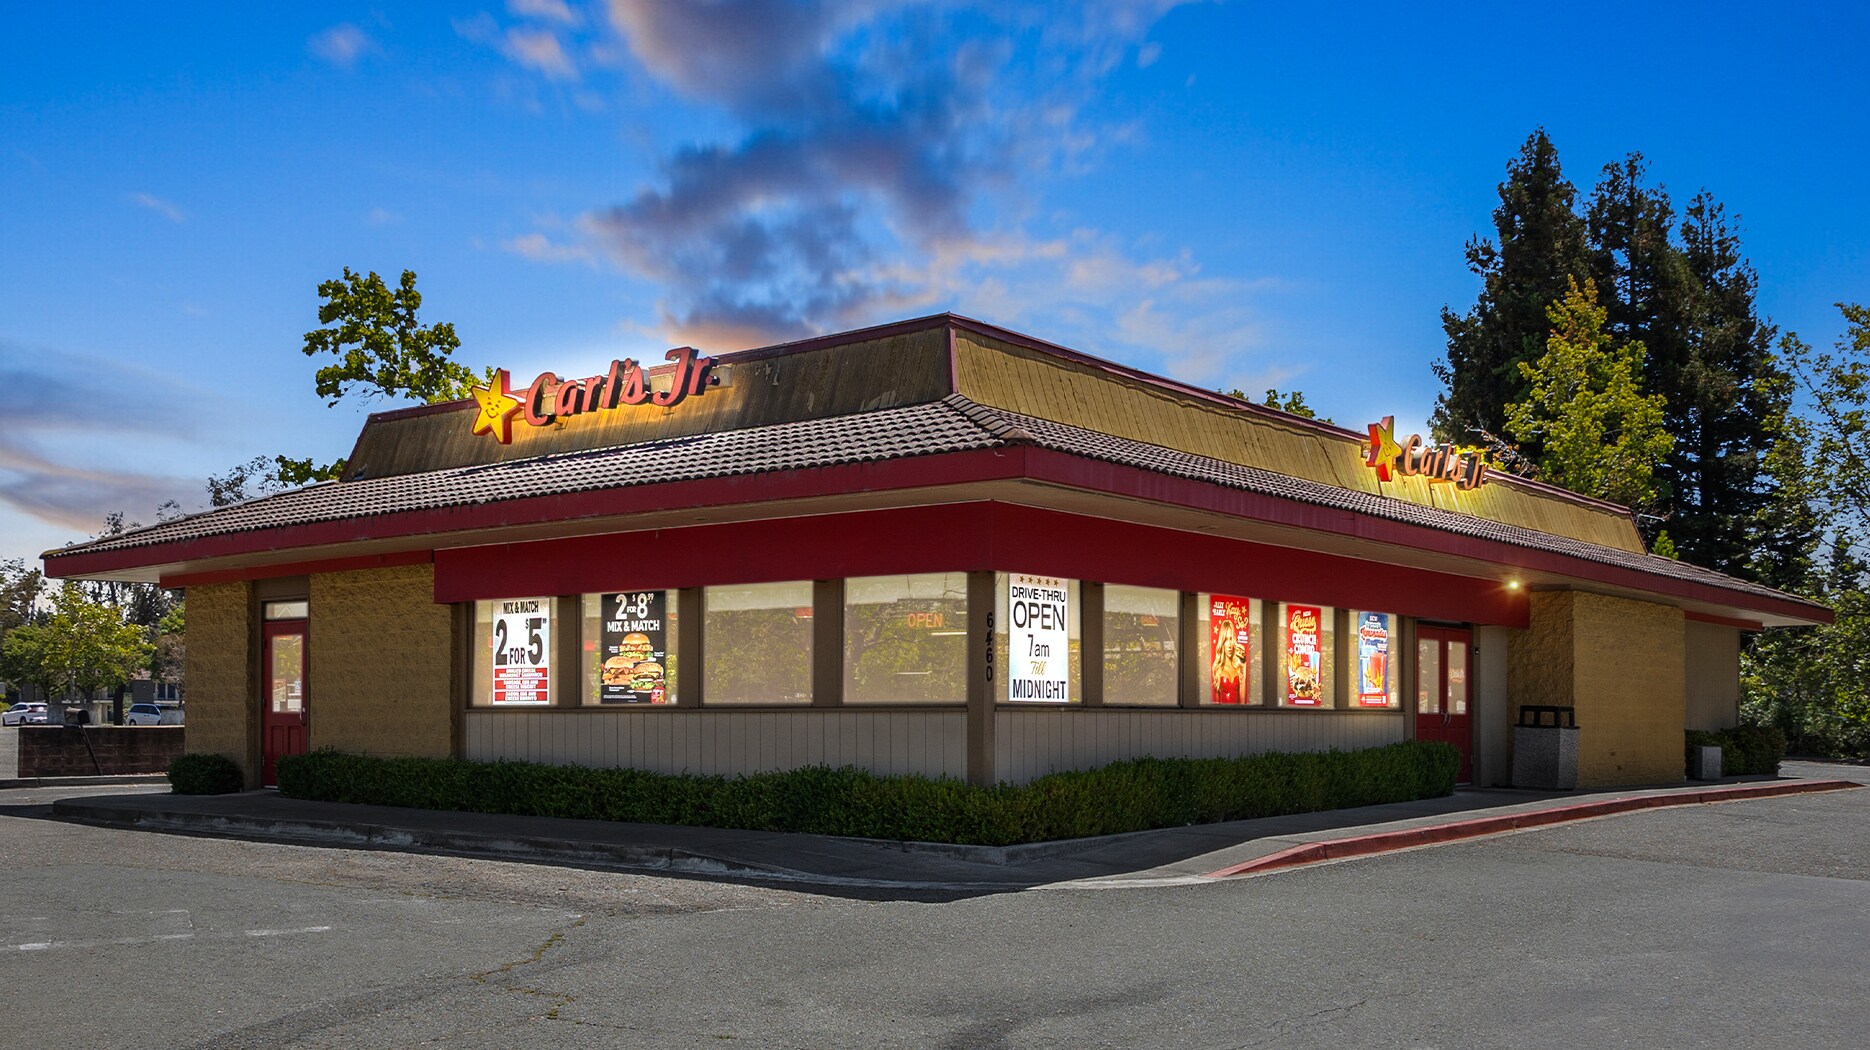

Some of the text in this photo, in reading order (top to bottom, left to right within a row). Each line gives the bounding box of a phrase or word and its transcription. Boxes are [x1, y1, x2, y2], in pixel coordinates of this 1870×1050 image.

[524, 346, 720, 427] Carl's Jr.
[1398, 433, 1461, 482] Carl's
[1012, 586, 1066, 603] DRIVE-THRU
[503, 601, 539, 614] MIX & MATCH
[615, 594, 627, 620] 2
[1013, 600, 1065, 631] OPEN
[607, 620, 660, 632] MIX & MATCH
[908, 611, 945, 629] OPEN
[495, 619, 508, 666] 2
[509, 647, 526, 665] FOR
[1027, 634, 1050, 657] 7am
[1030, 660, 1047, 676] Till
[1013, 679, 1066, 699] MIDNIGHT
